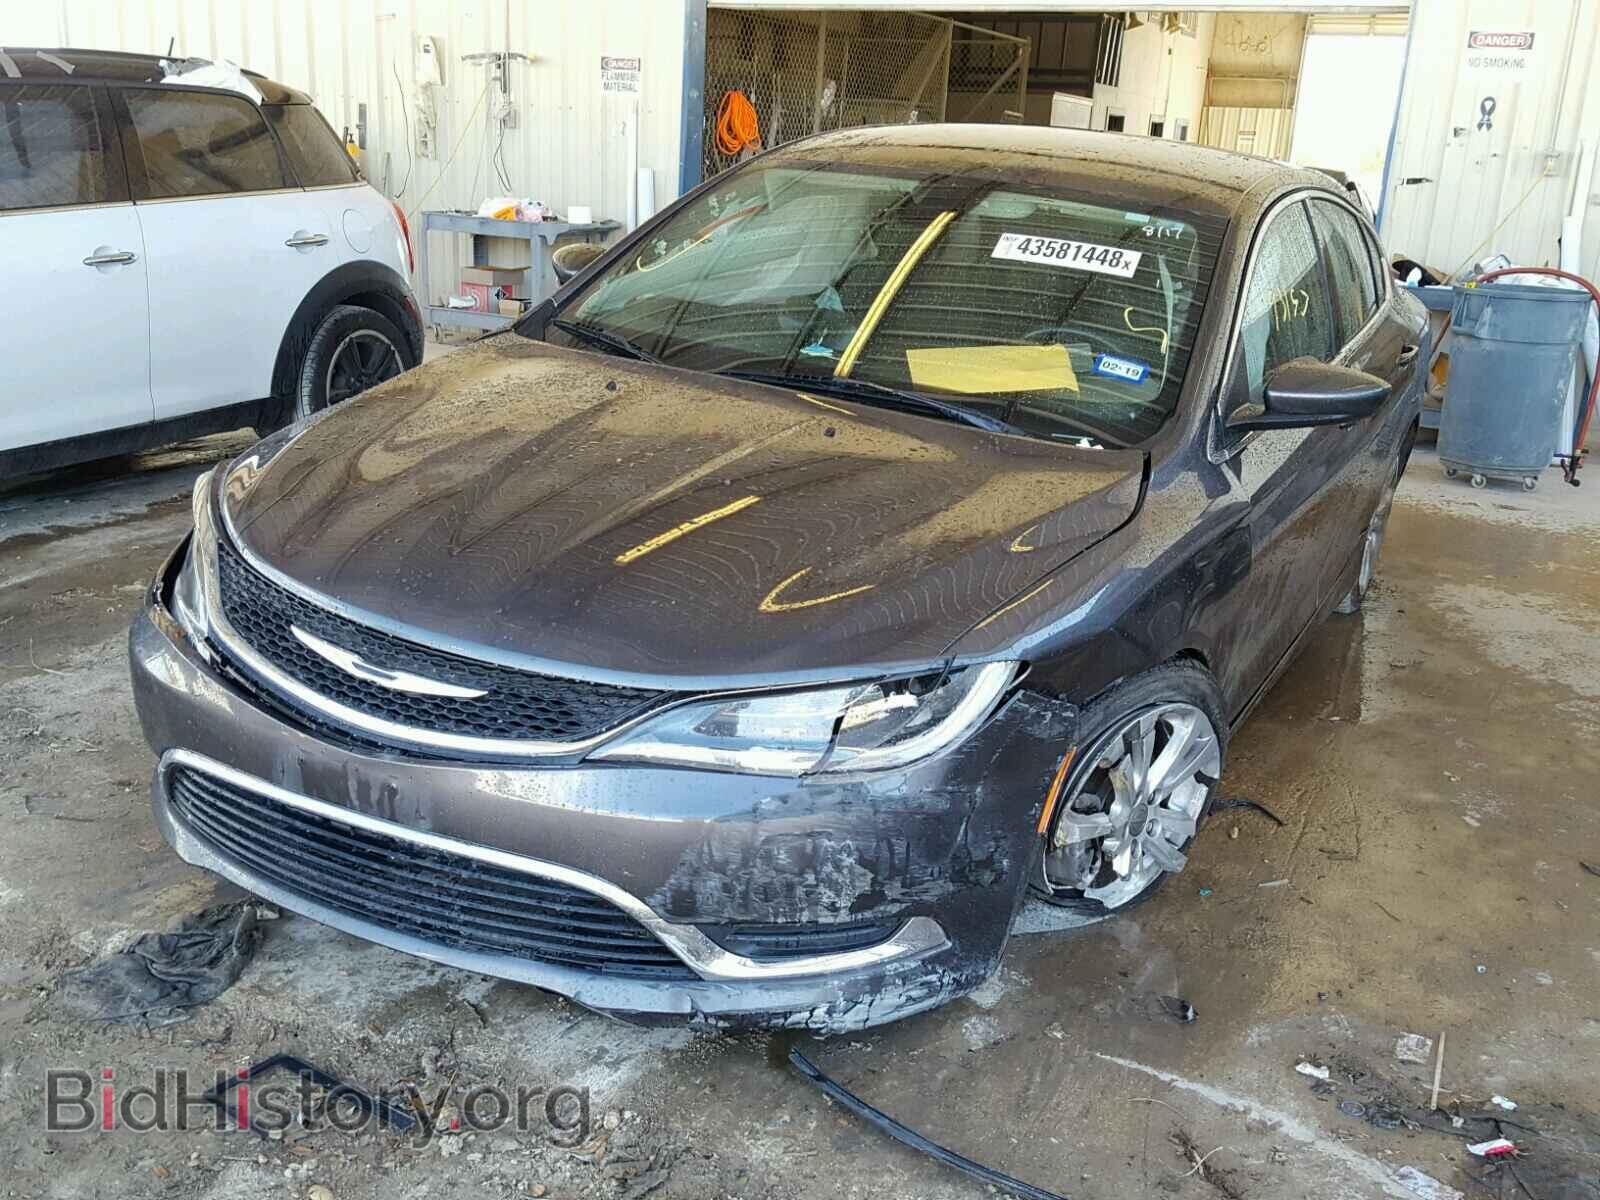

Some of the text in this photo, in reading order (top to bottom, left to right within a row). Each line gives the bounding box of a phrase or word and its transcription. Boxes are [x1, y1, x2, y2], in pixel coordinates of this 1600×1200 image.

[1475, 34, 1526, 47] DANGER
[606, 59, 638, 69] DANGER
[1468, 56, 1526, 69] NO SMOKING
